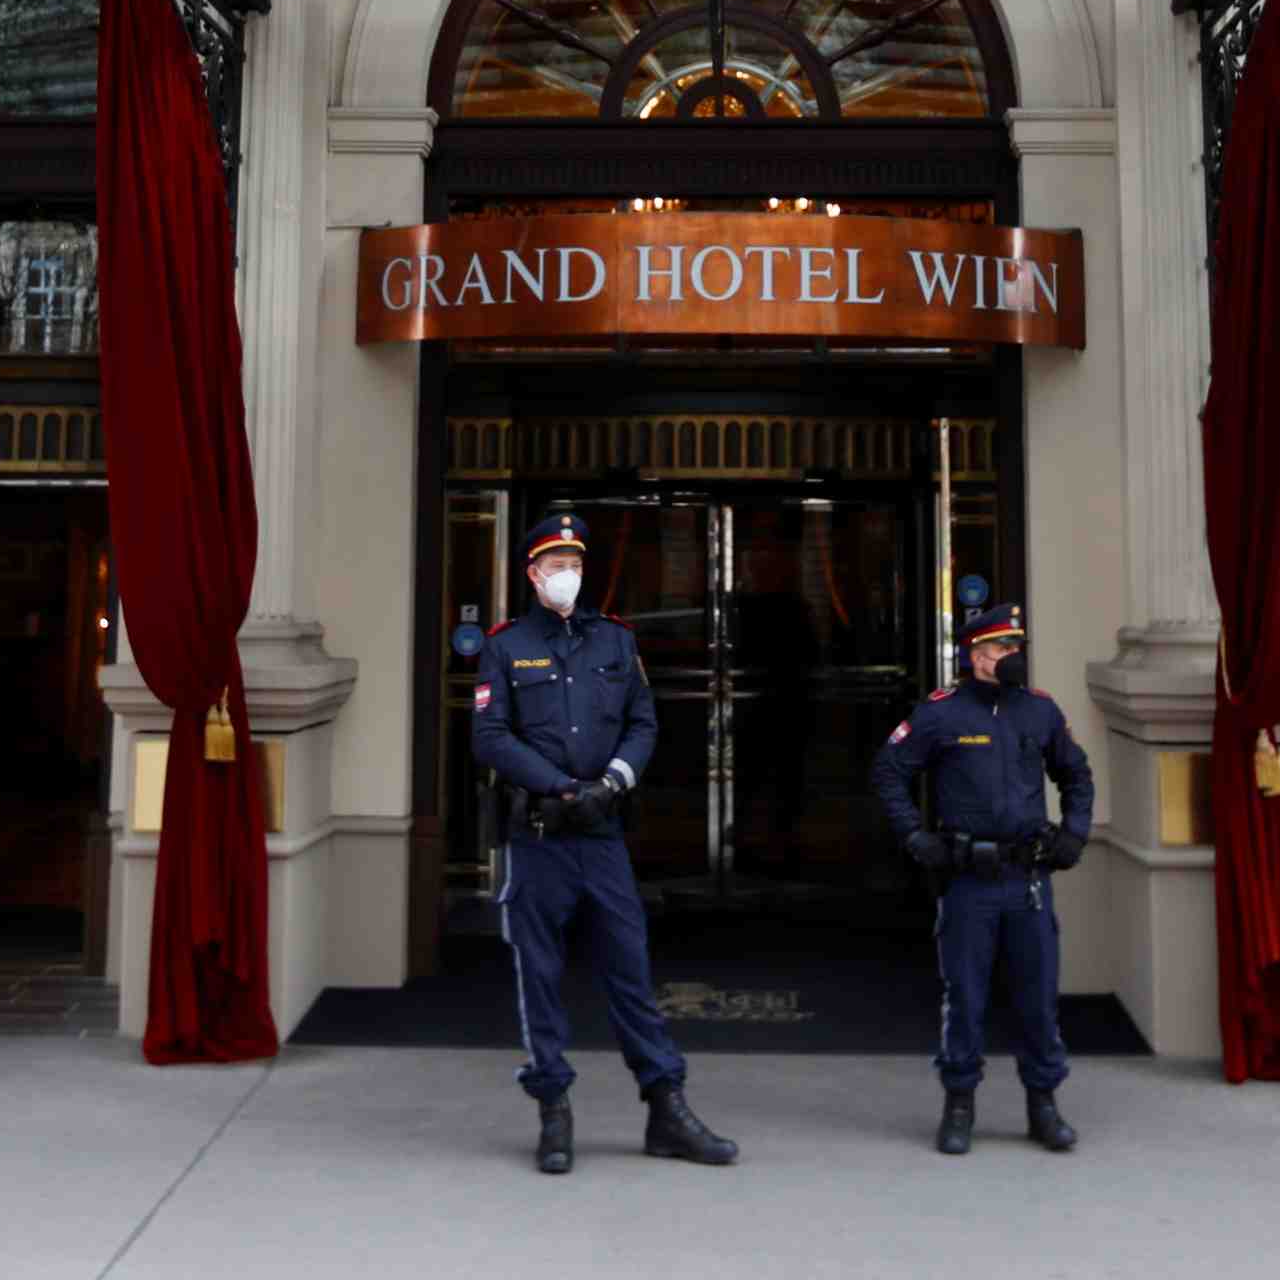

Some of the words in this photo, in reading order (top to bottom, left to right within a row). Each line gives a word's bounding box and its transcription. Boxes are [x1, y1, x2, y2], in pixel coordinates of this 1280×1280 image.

[381, 247, 607, 311] GRAND
[634, 244, 885, 305] HOTEL
[907, 250, 1059, 315] WIEN
